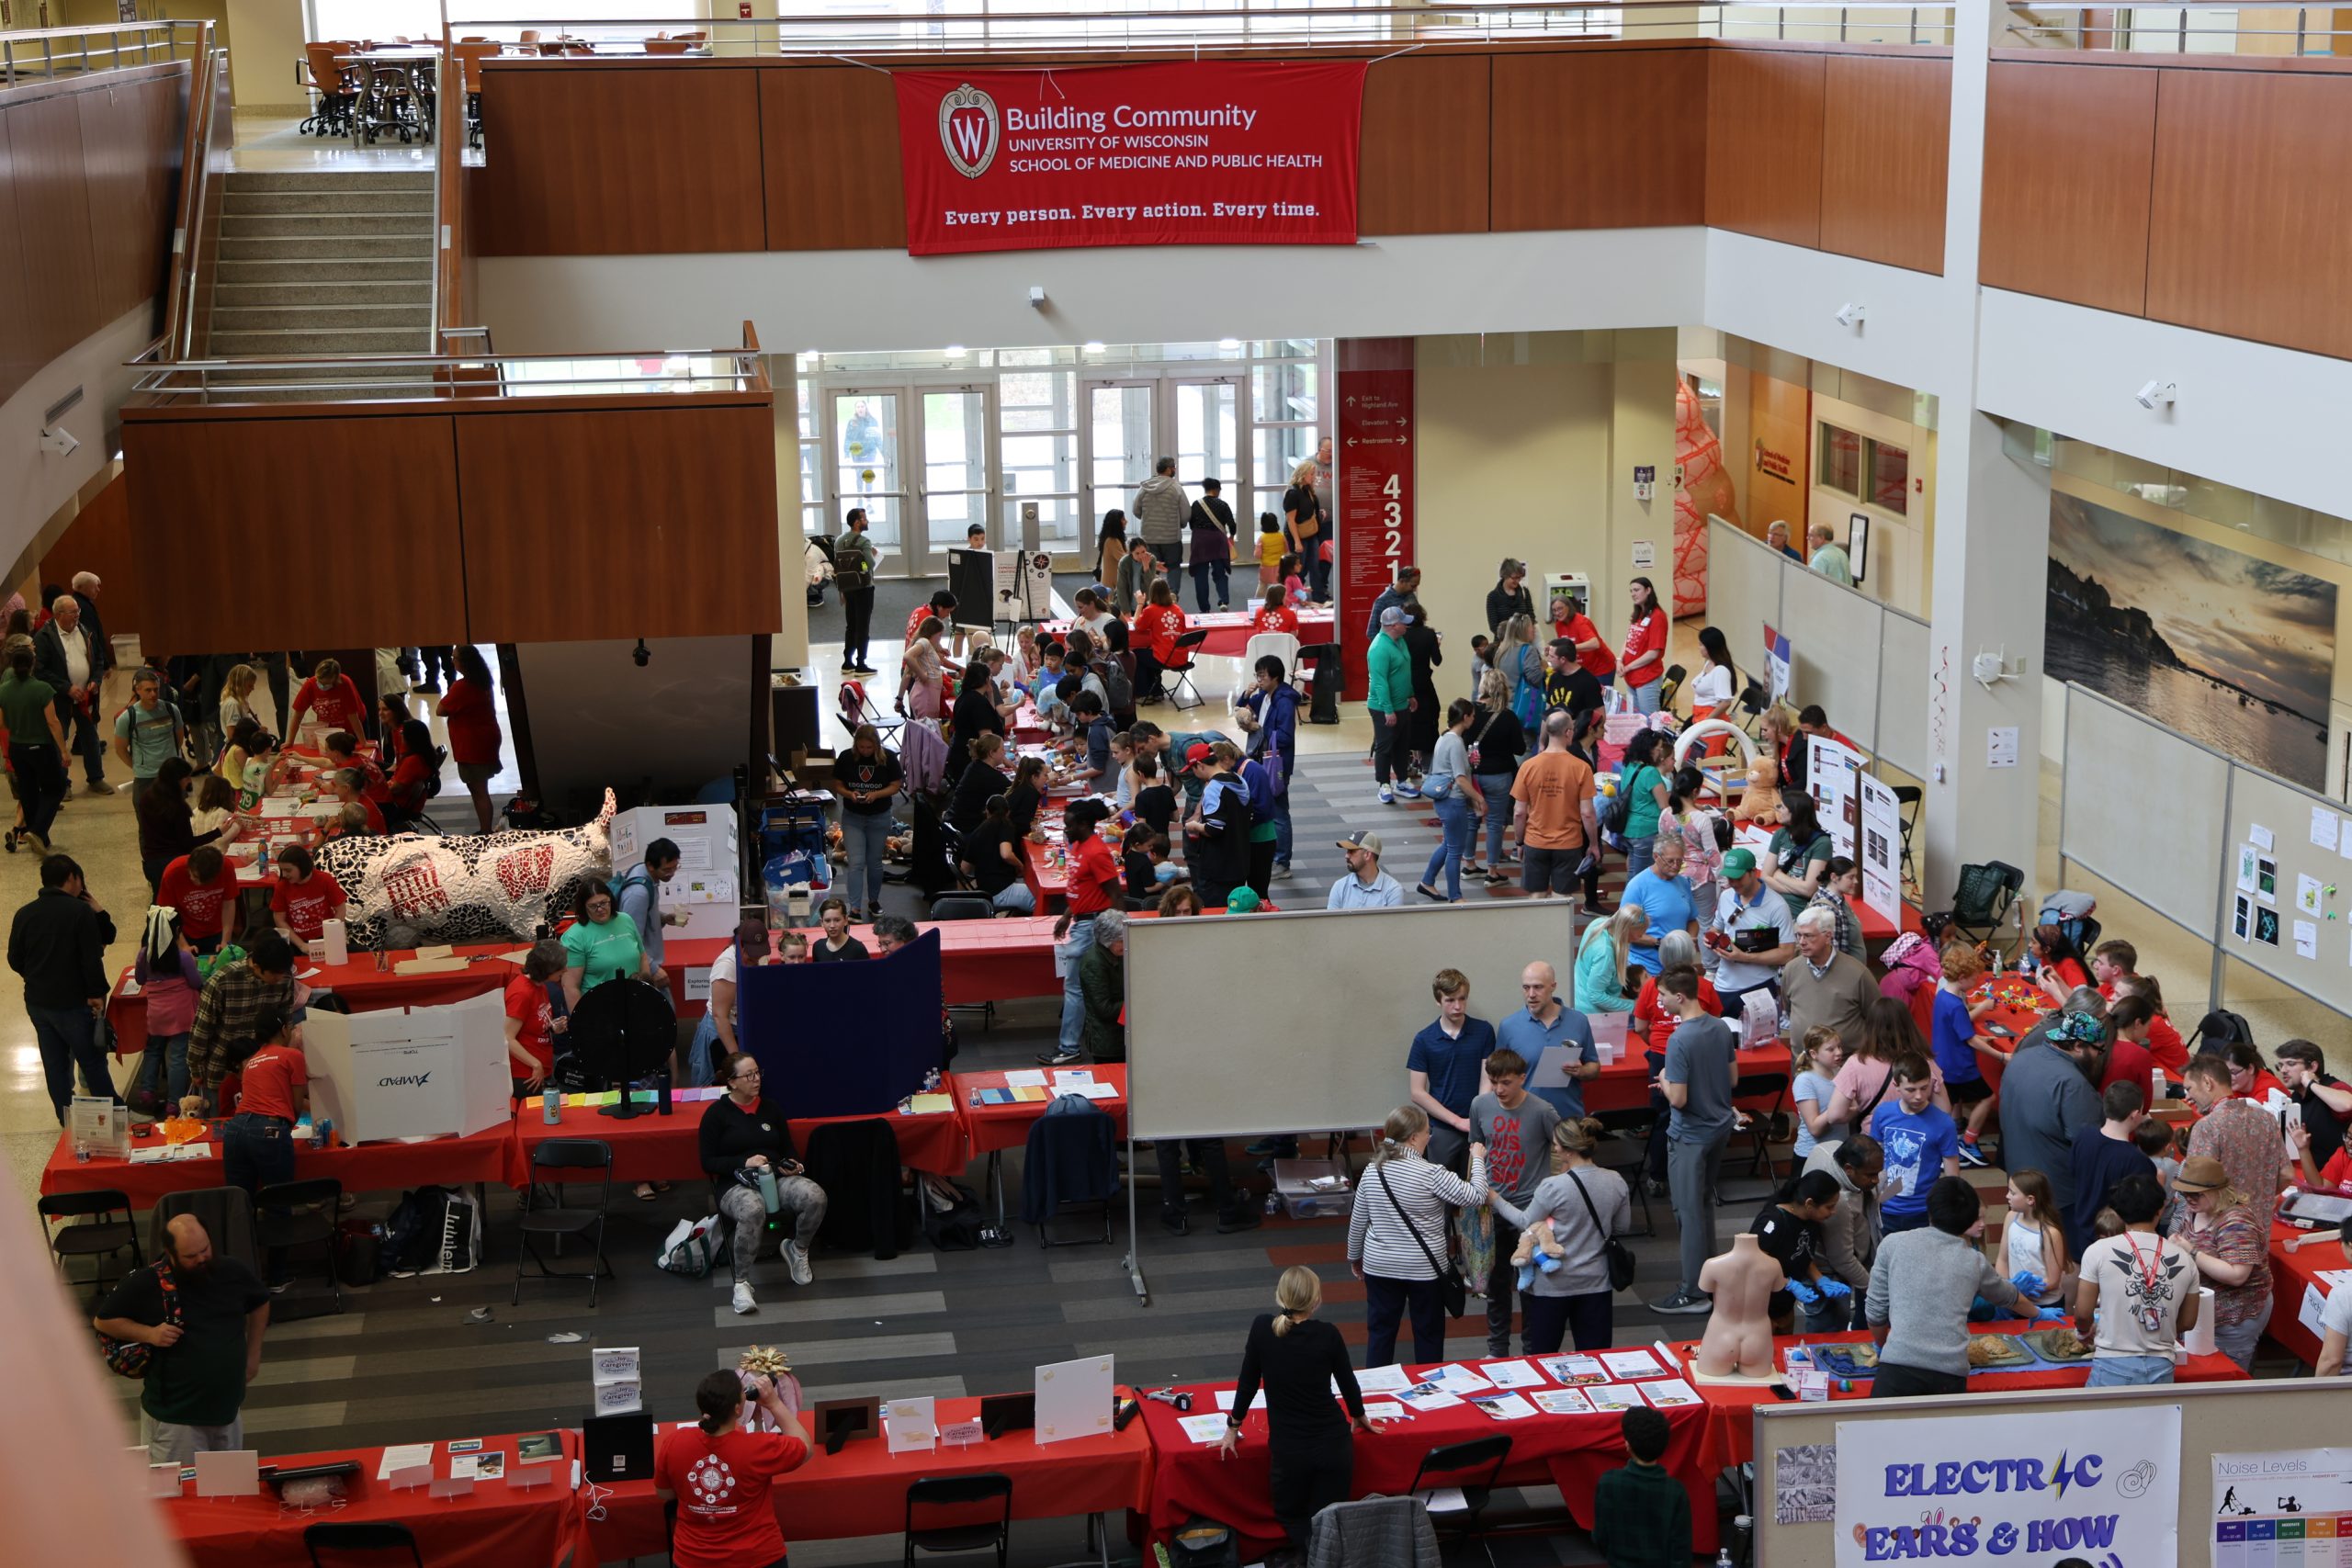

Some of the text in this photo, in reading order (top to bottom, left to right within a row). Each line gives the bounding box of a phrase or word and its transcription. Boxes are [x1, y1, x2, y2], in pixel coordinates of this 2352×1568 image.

[1007, 104, 1257, 133] Building Community
[953, 115, 985, 160] W
[1009, 135, 1209, 152] UNIVERSITY OF WISCONSIN
[1010, 154, 1323, 173] SCHOOL OF MEDICINE AND PUBLIC HEALTH
[945, 201, 1320, 226] Every person. Every action. Every time.
[1383, 474, 1402, 500] 4
[1384, 502, 1402, 527] 3
[1385, 530, 1401, 556] 2
[1386, 559, 1398, 585] 1
[378, 1070, 432, 1088] AMPAD
[1493, 1115, 1521, 1134] ON
[1489, 1148, 1527, 1168] CON
[1491, 1165, 1520, 1184] SIN
[603, 1393, 634, 1401] Caregiver
[2218, 1460, 2307, 1474] Noise Levels
[1865, 1514, 2120, 1561] EARS & HOW
